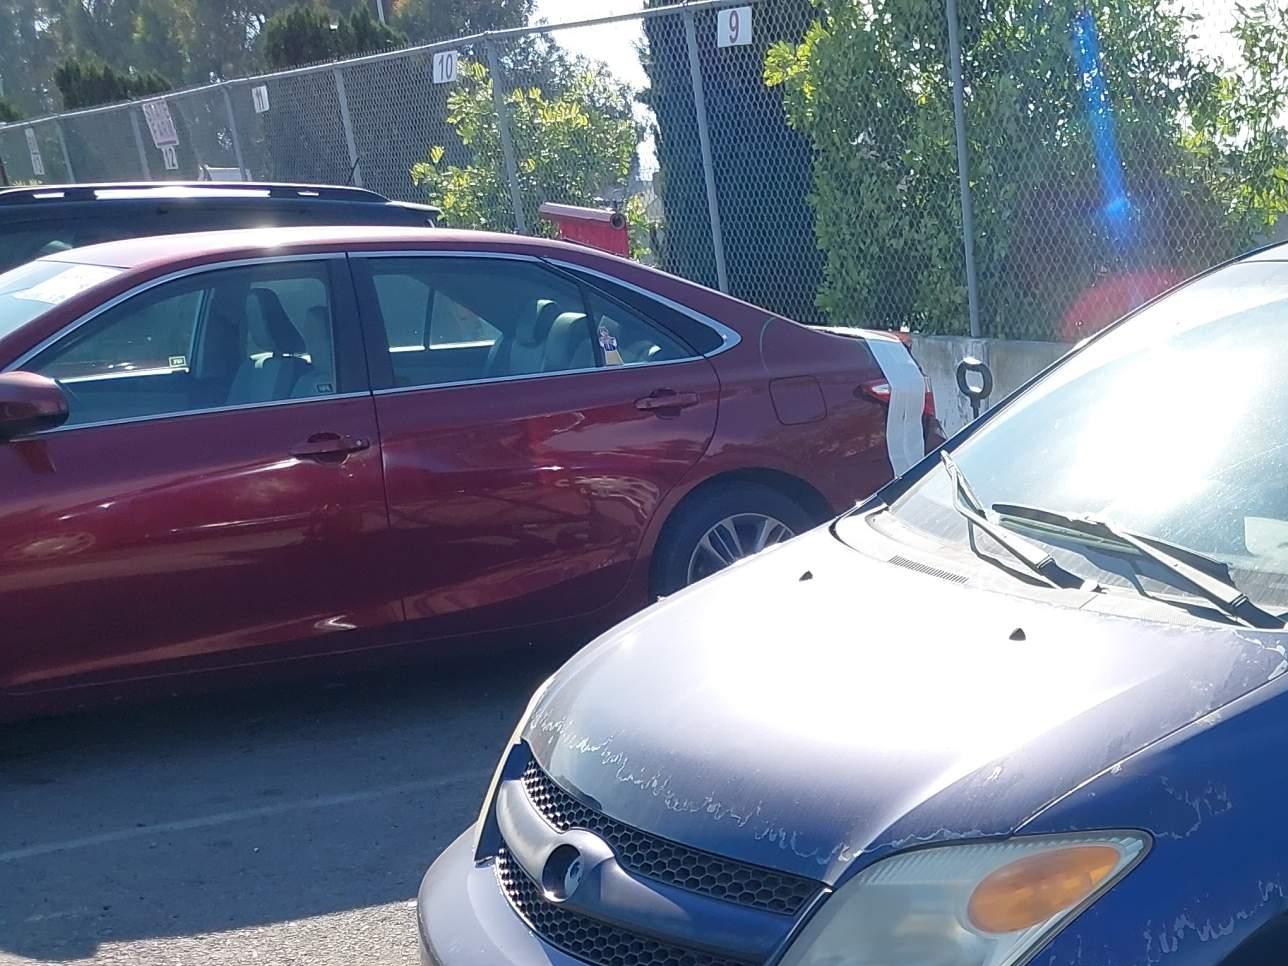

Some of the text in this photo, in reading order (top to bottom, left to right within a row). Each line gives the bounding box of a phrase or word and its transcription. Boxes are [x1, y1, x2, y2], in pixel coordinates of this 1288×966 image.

[729, 10, 739, 44] 9
[438, 53, 453, 81] 10
[255, 87, 265, 110] 11
[162, 147, 177, 169] 12
